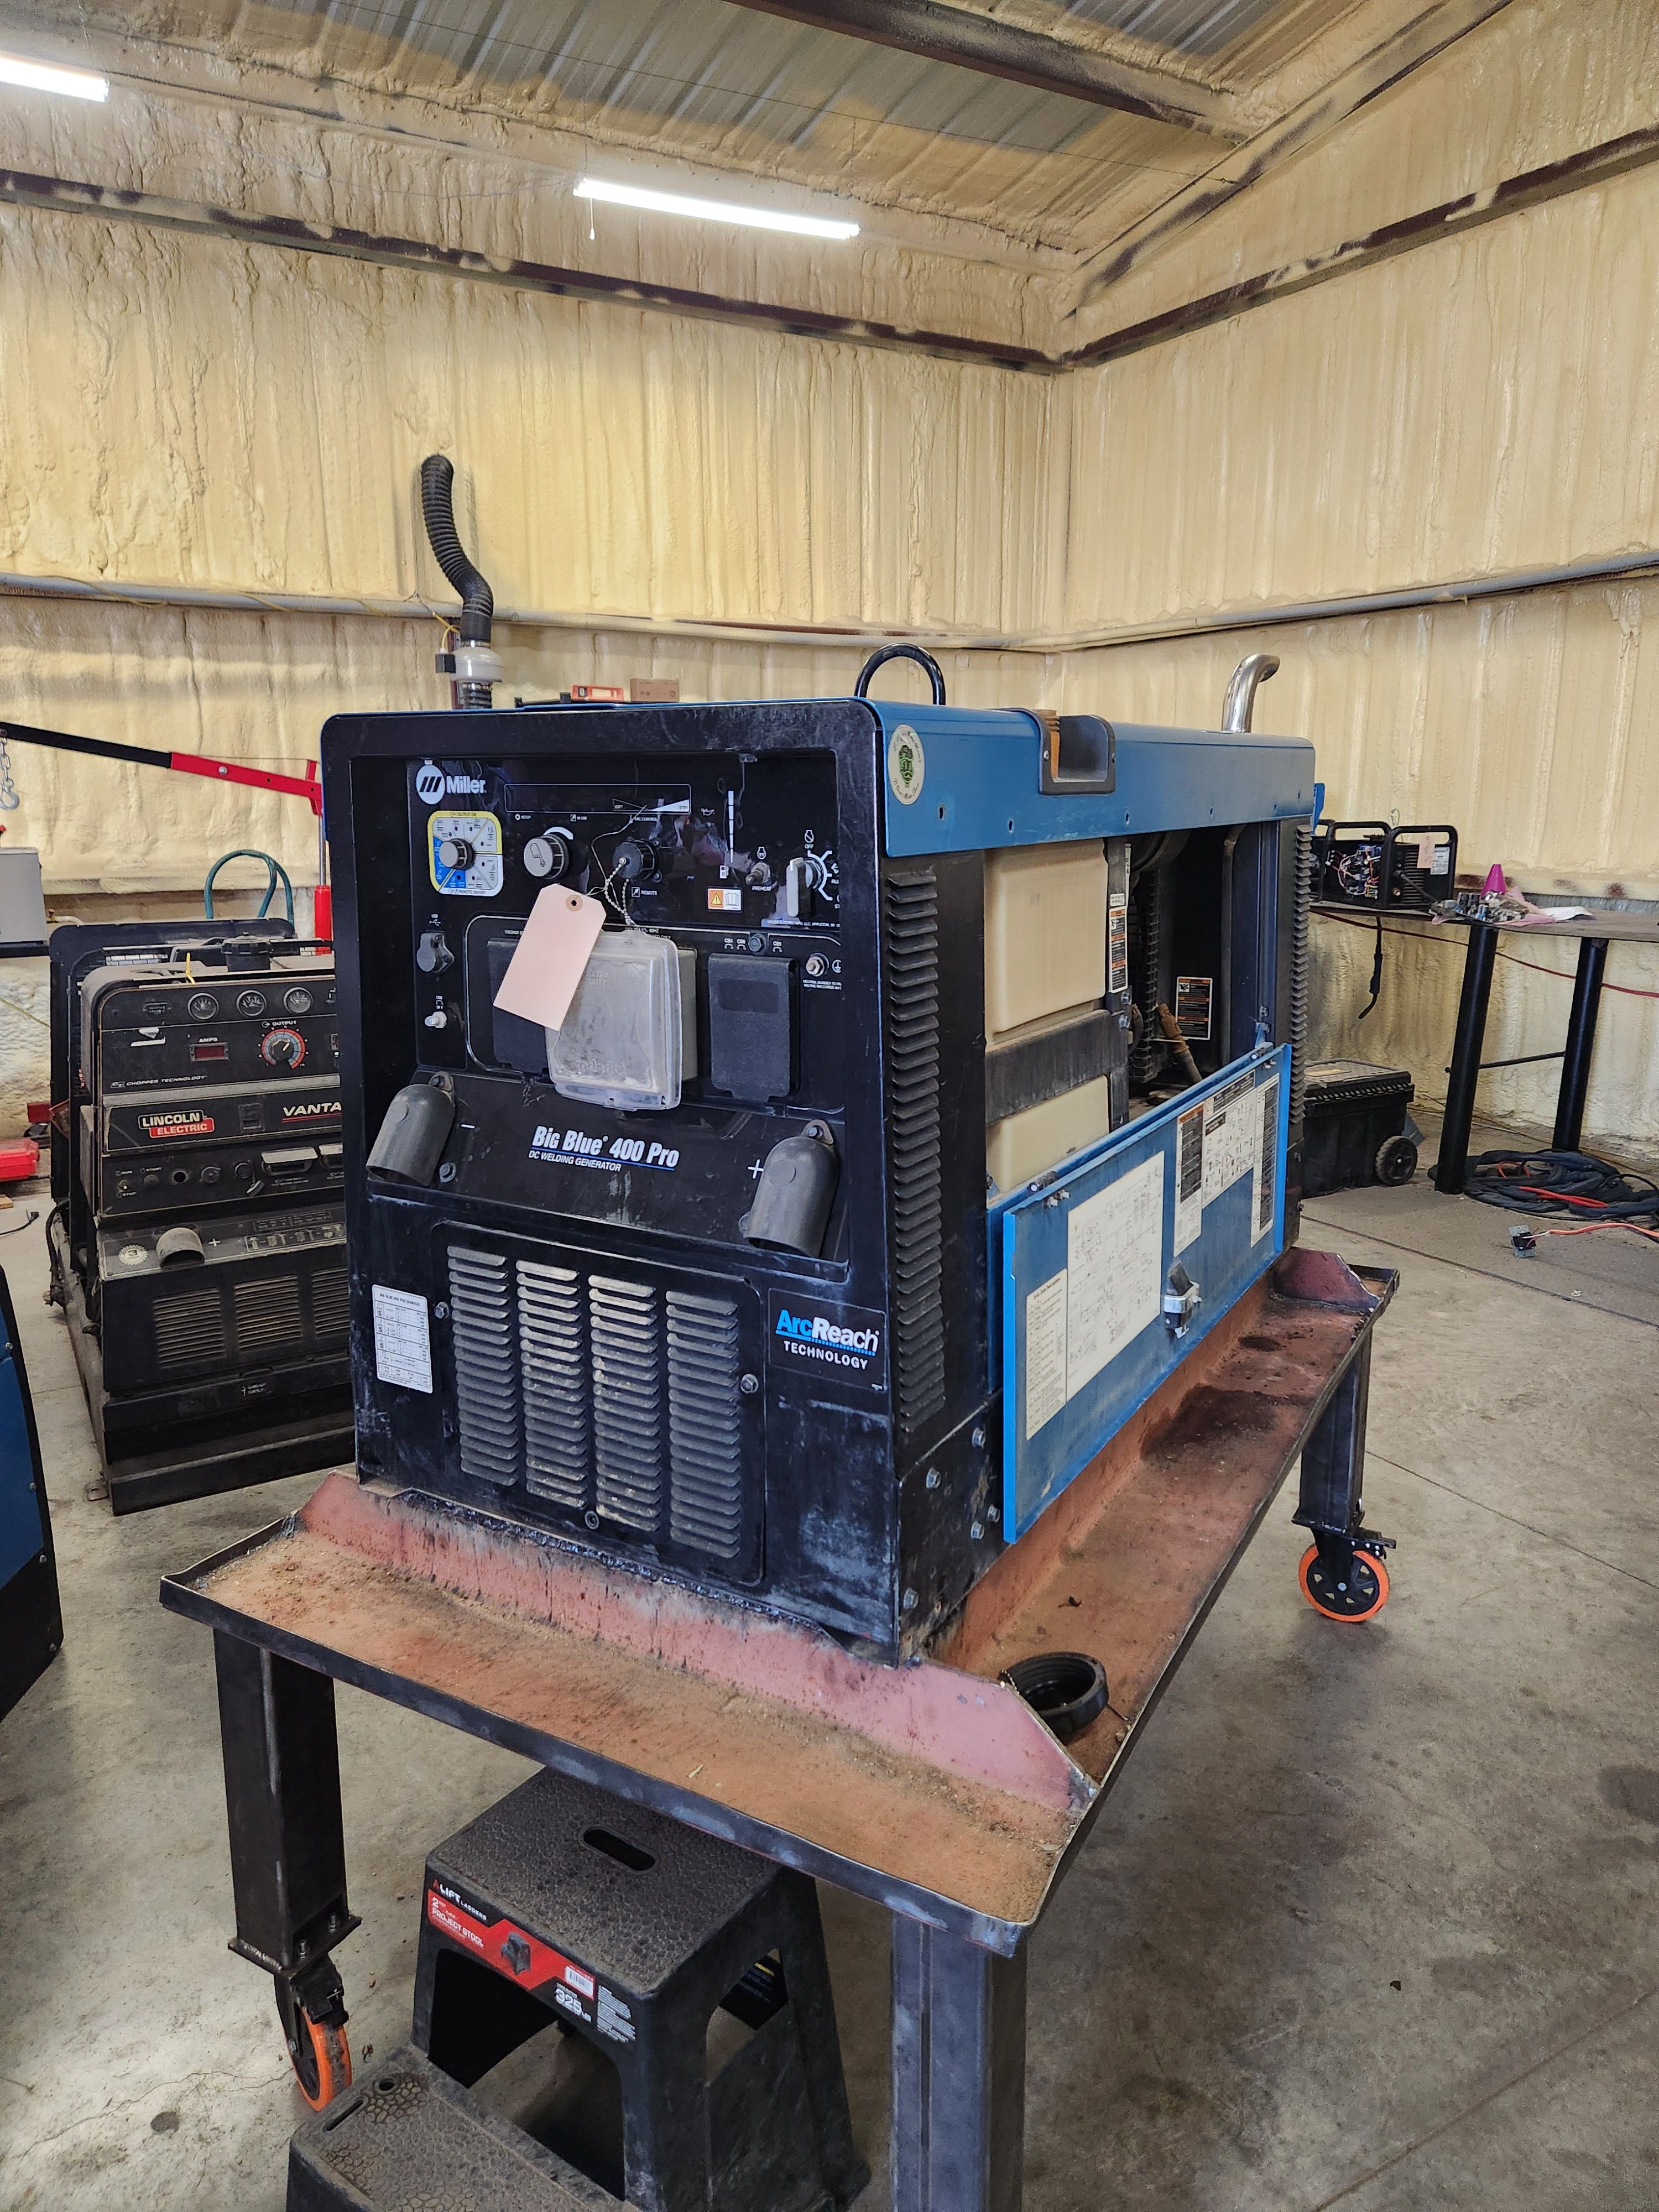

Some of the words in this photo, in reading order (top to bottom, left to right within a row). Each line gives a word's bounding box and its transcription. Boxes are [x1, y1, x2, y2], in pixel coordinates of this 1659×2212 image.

[446, 775, 486, 794] Miller
[142, 1112, 200, 1127] LINCOLN
[283, 1102, 342, 1117] VANTA
[157, 1123, 207, 1135] ELECTRIC
[531, 1125, 561, 1149] Big
[609, 1137, 645, 1162] 400
[646, 1142, 680, 1167] Pro
[528, 1150, 540, 1159] DC
[540, 1152, 575, 1165] WELDING
[575, 1156, 622, 1172] GENERATOR
[776, 1310, 878, 1353] ArcReach
[784, 1340, 868, 1370] TECHNOLOGY
[440, 1883, 461, 1903] LIFT
[461, 1900, 487, 1921] LADDERS
[432, 1907, 462, 1932] PROJECT
[462, 1928, 484, 1948] STOOL
[555, 1987, 582, 2016] 325
